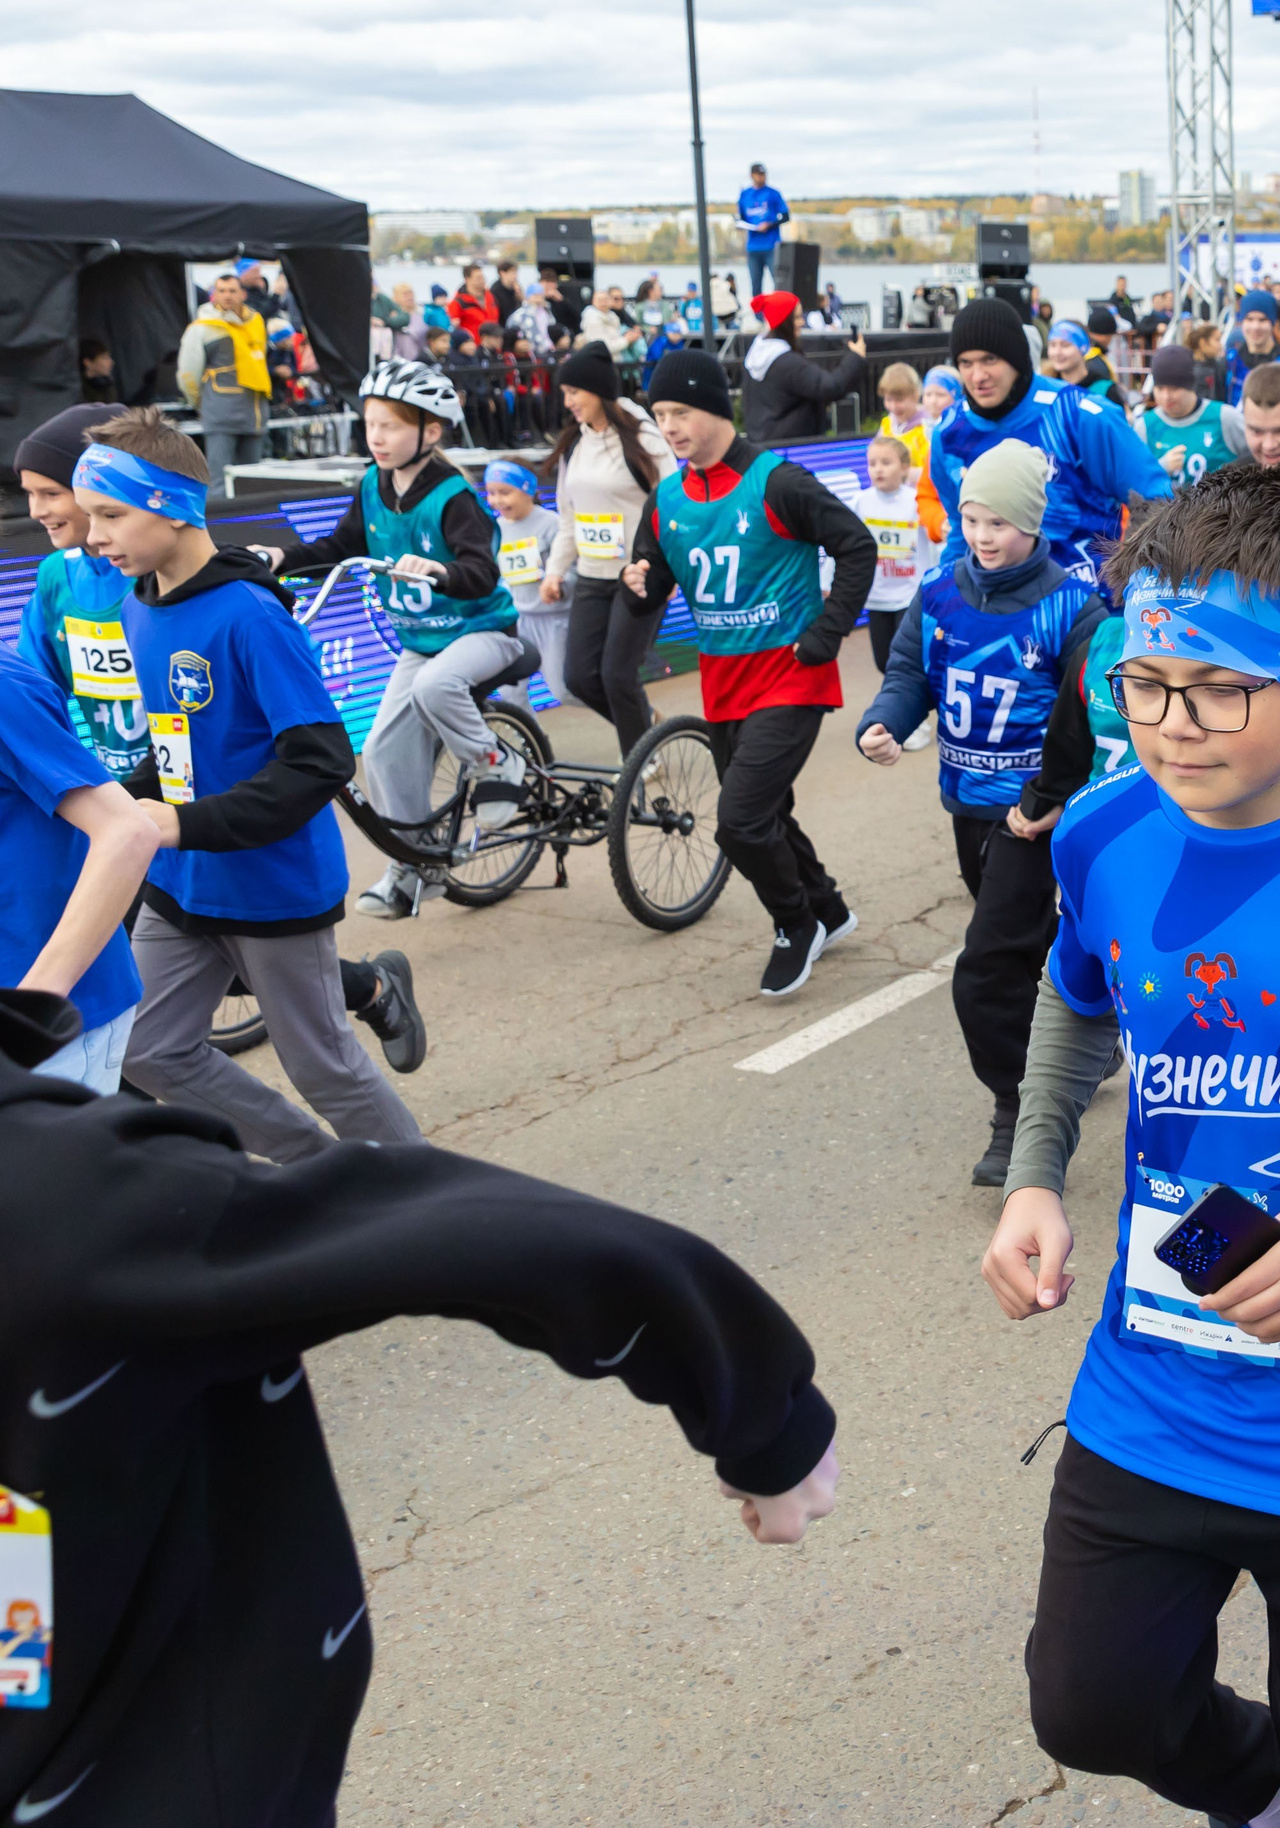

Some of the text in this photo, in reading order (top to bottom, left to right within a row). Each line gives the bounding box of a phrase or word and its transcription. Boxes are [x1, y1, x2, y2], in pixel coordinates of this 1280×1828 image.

[582, 527, 612, 543] 126
[880, 531, 900, 545] 61
[506, 555, 528, 570] 73
[688, 545, 740, 604] 27
[80, 646, 133, 674] 125
[945, 666, 1020, 744] 57
[1089, 765, 1142, 792] LEAGUE
[1149, 1178, 1185, 1198] 1000
[1151, 1191, 1180, 1204] метров
